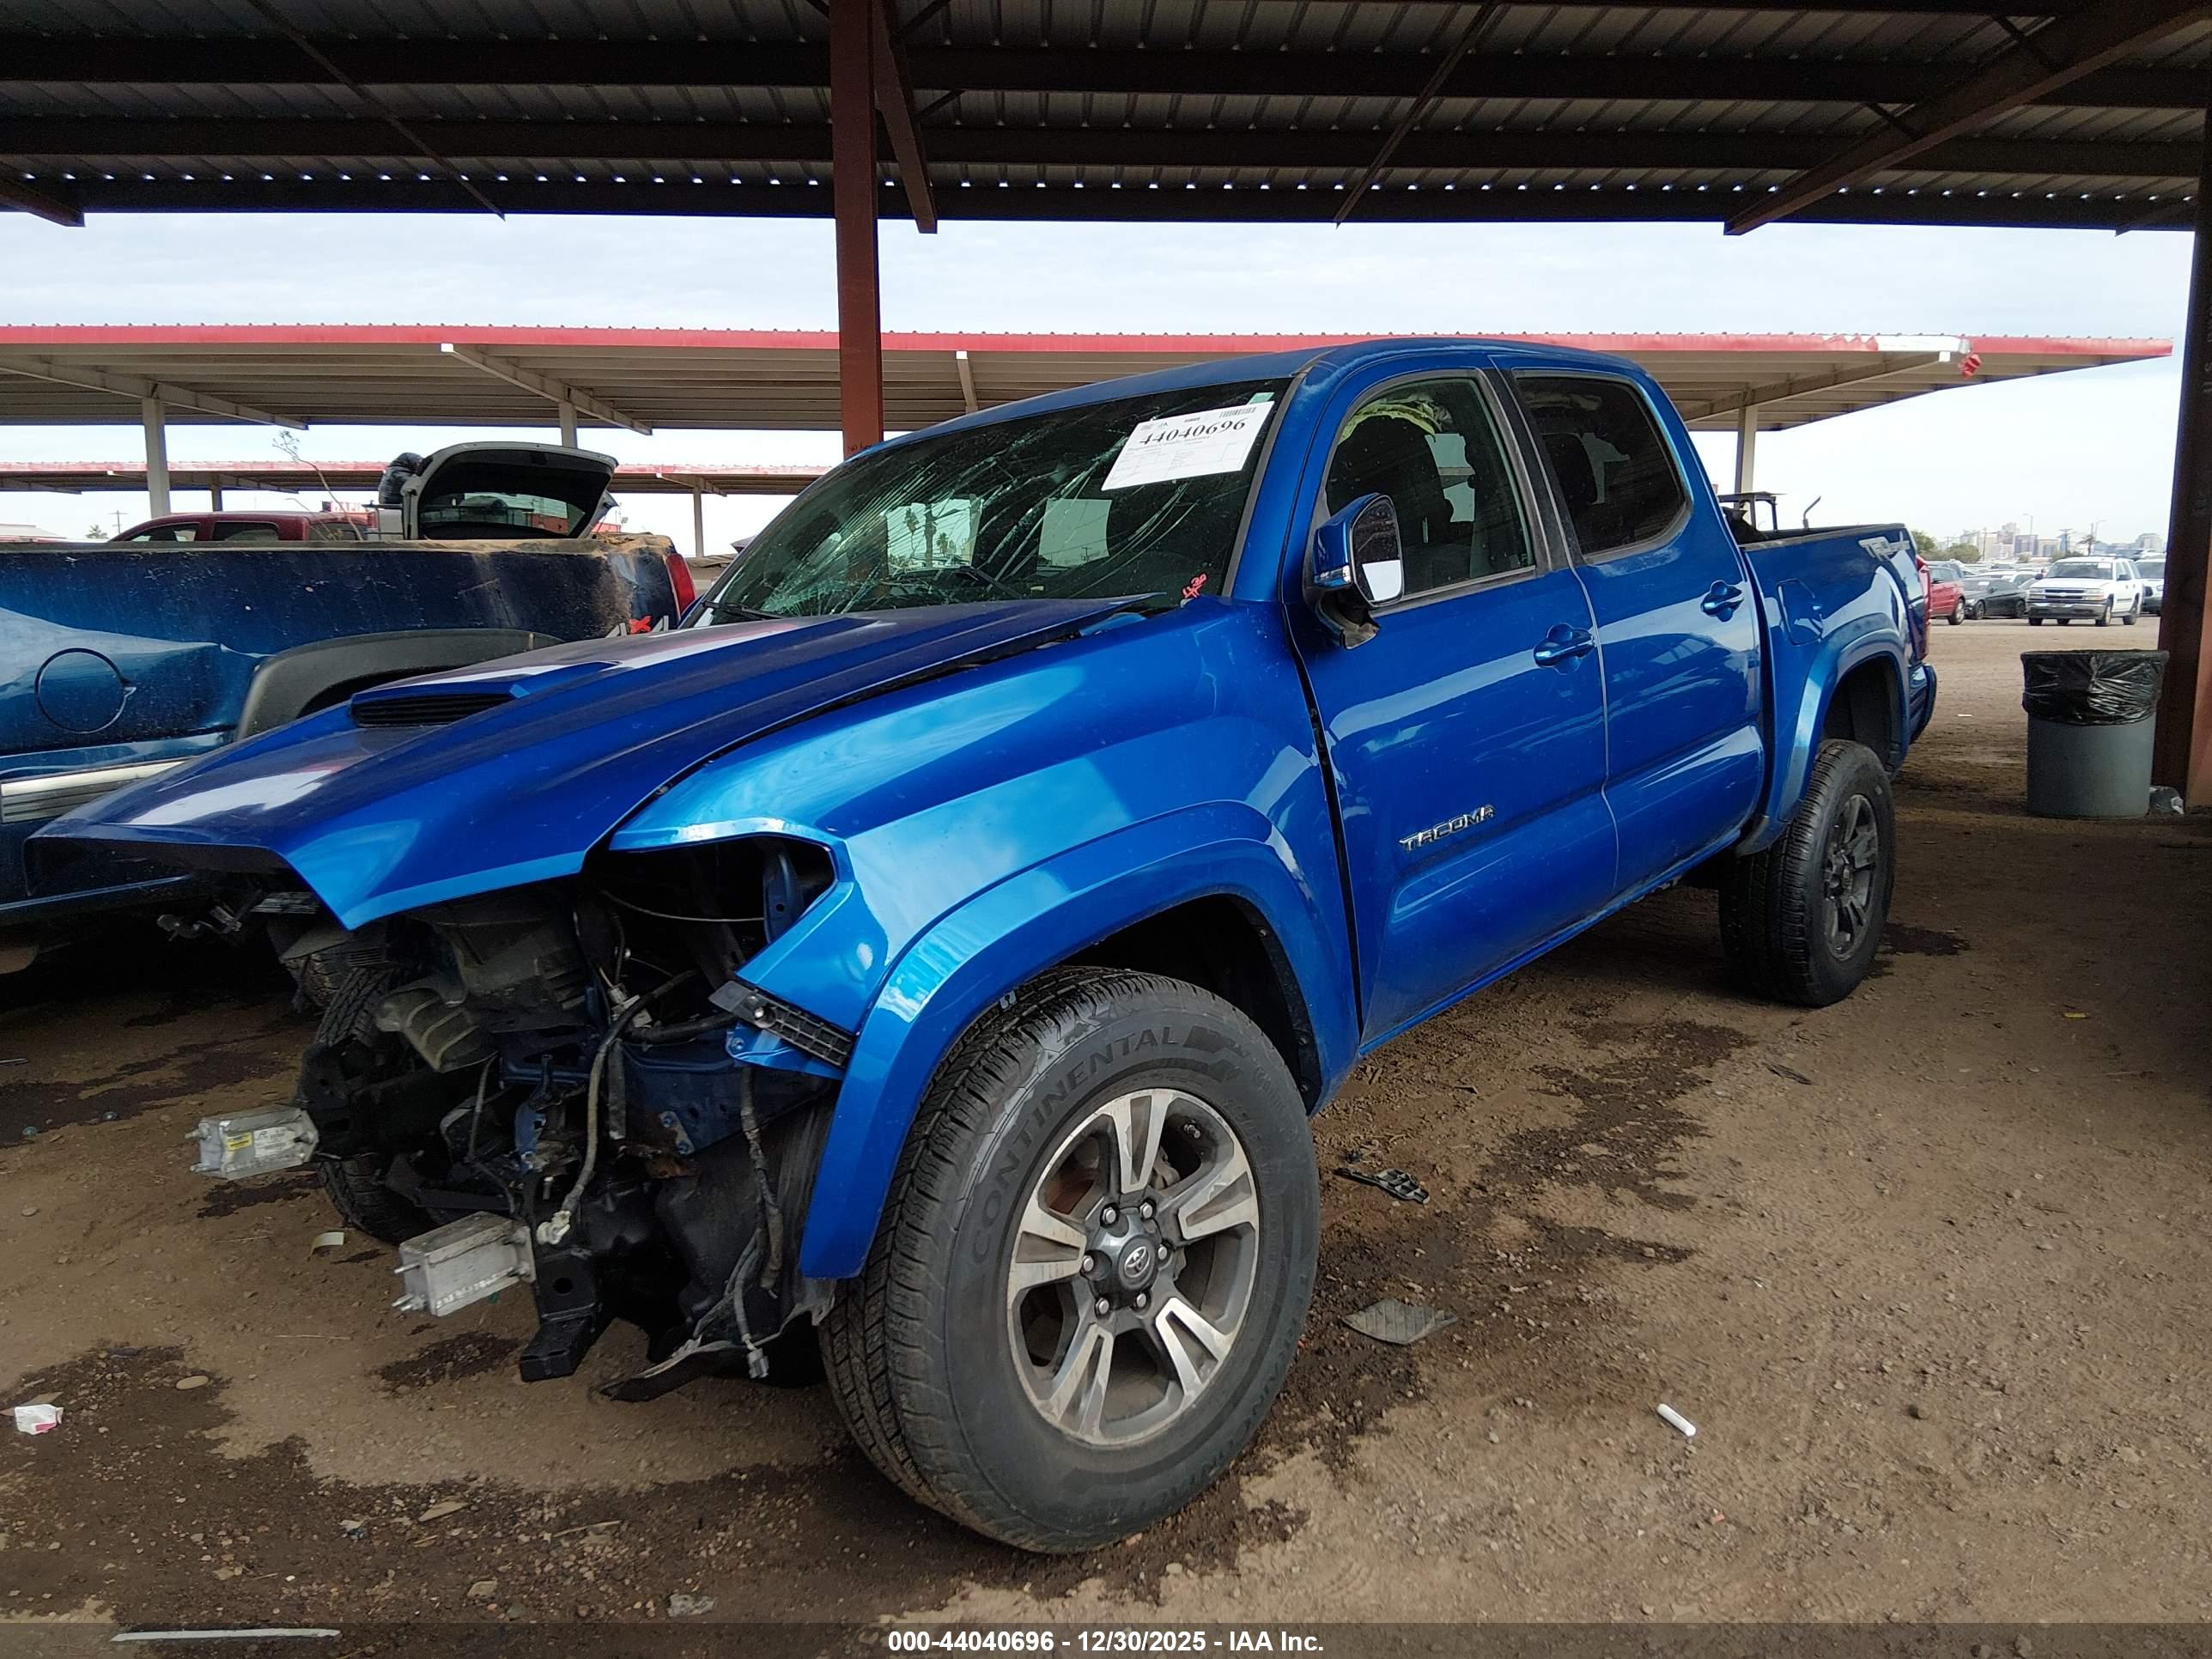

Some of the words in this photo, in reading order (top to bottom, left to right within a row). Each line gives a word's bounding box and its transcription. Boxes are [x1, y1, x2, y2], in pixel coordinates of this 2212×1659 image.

[1139, 418, 1248, 445] 44040696
[1399, 804, 1496, 852] TACOMA
[973, 1025, 1180, 1256] CONTINENTAL
